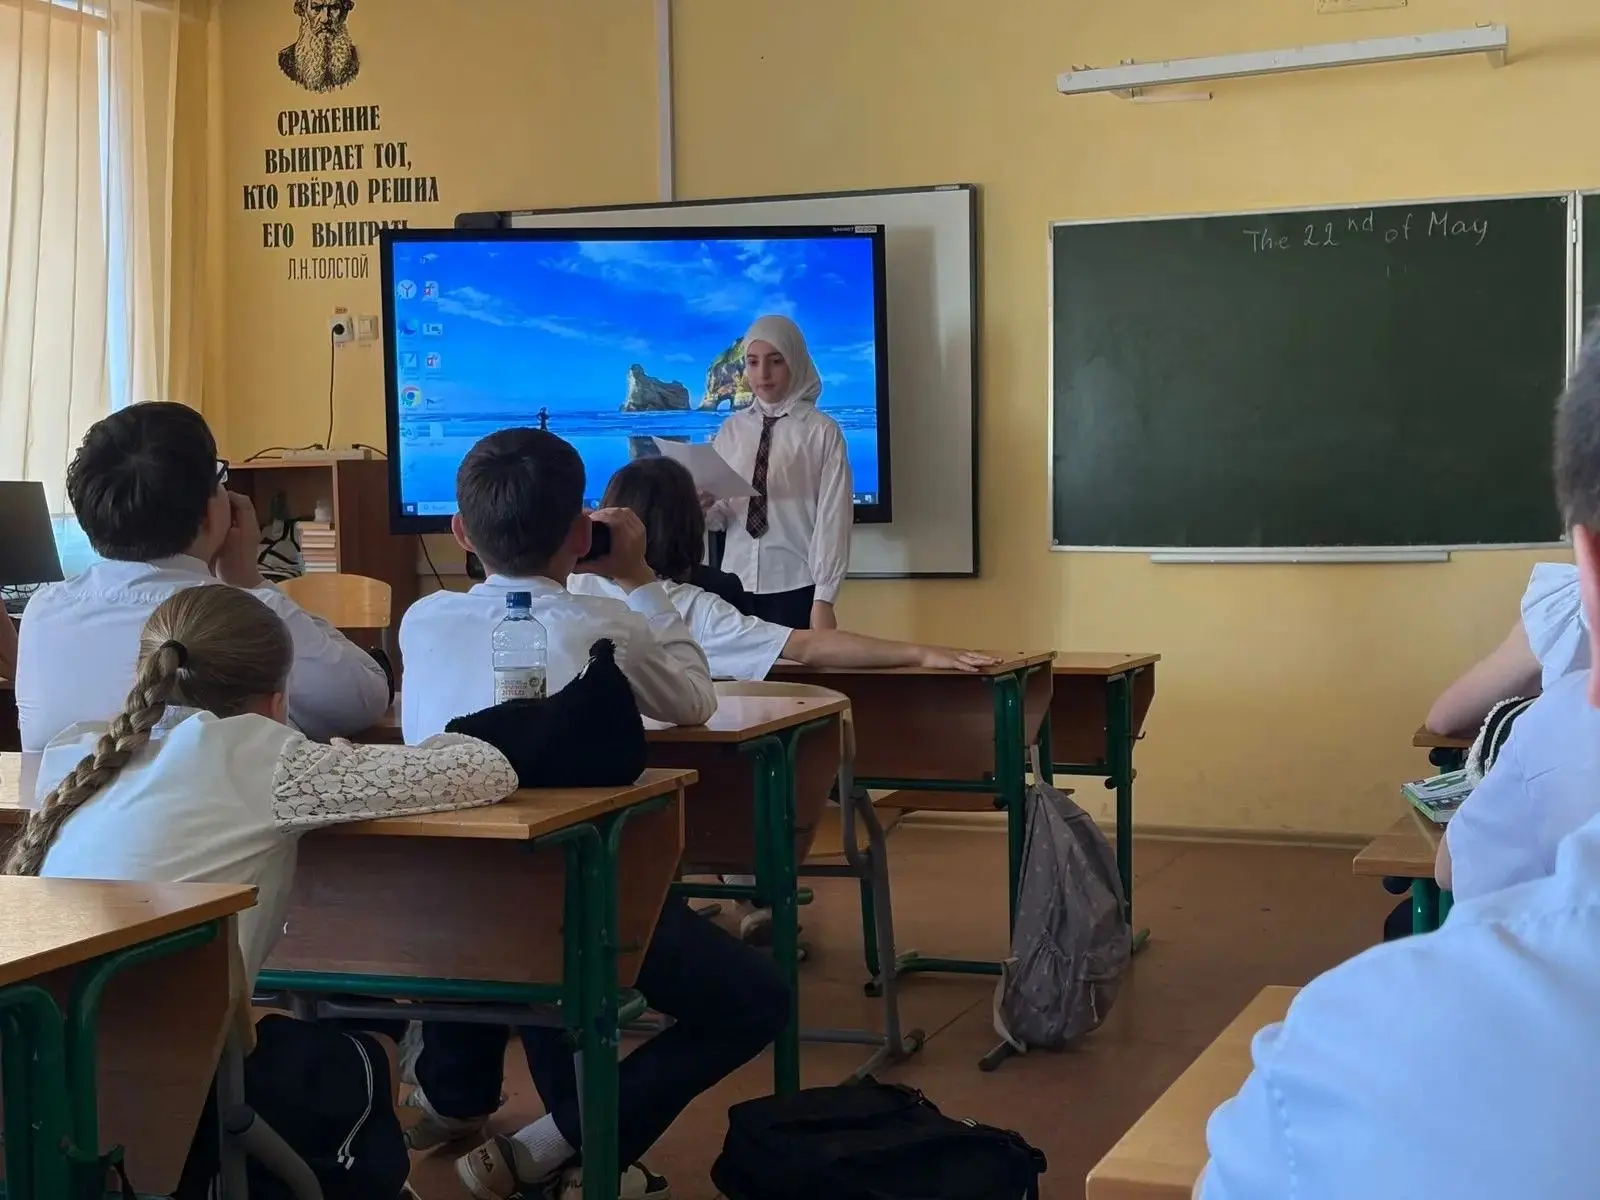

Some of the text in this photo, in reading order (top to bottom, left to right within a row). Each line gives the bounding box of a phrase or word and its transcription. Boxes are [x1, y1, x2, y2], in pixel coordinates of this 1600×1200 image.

[277, 105, 381, 136] СРАЖЕНИЕ
[265, 142, 412, 174] ВЫИГРАЕТ ТОТ,
[243, 176, 440, 210] КТО ТВЁРДО РЕШИЛ
[262, 223, 294, 248] ЕГО
[1243, 229, 1291, 253] The
[1385, 213, 1413, 243] of
[1428, 212, 1490, 246] May
[287, 253, 369, 280] Л.Н.ТОЛСТОЙ
[479, 1148, 494, 1172] FILA
